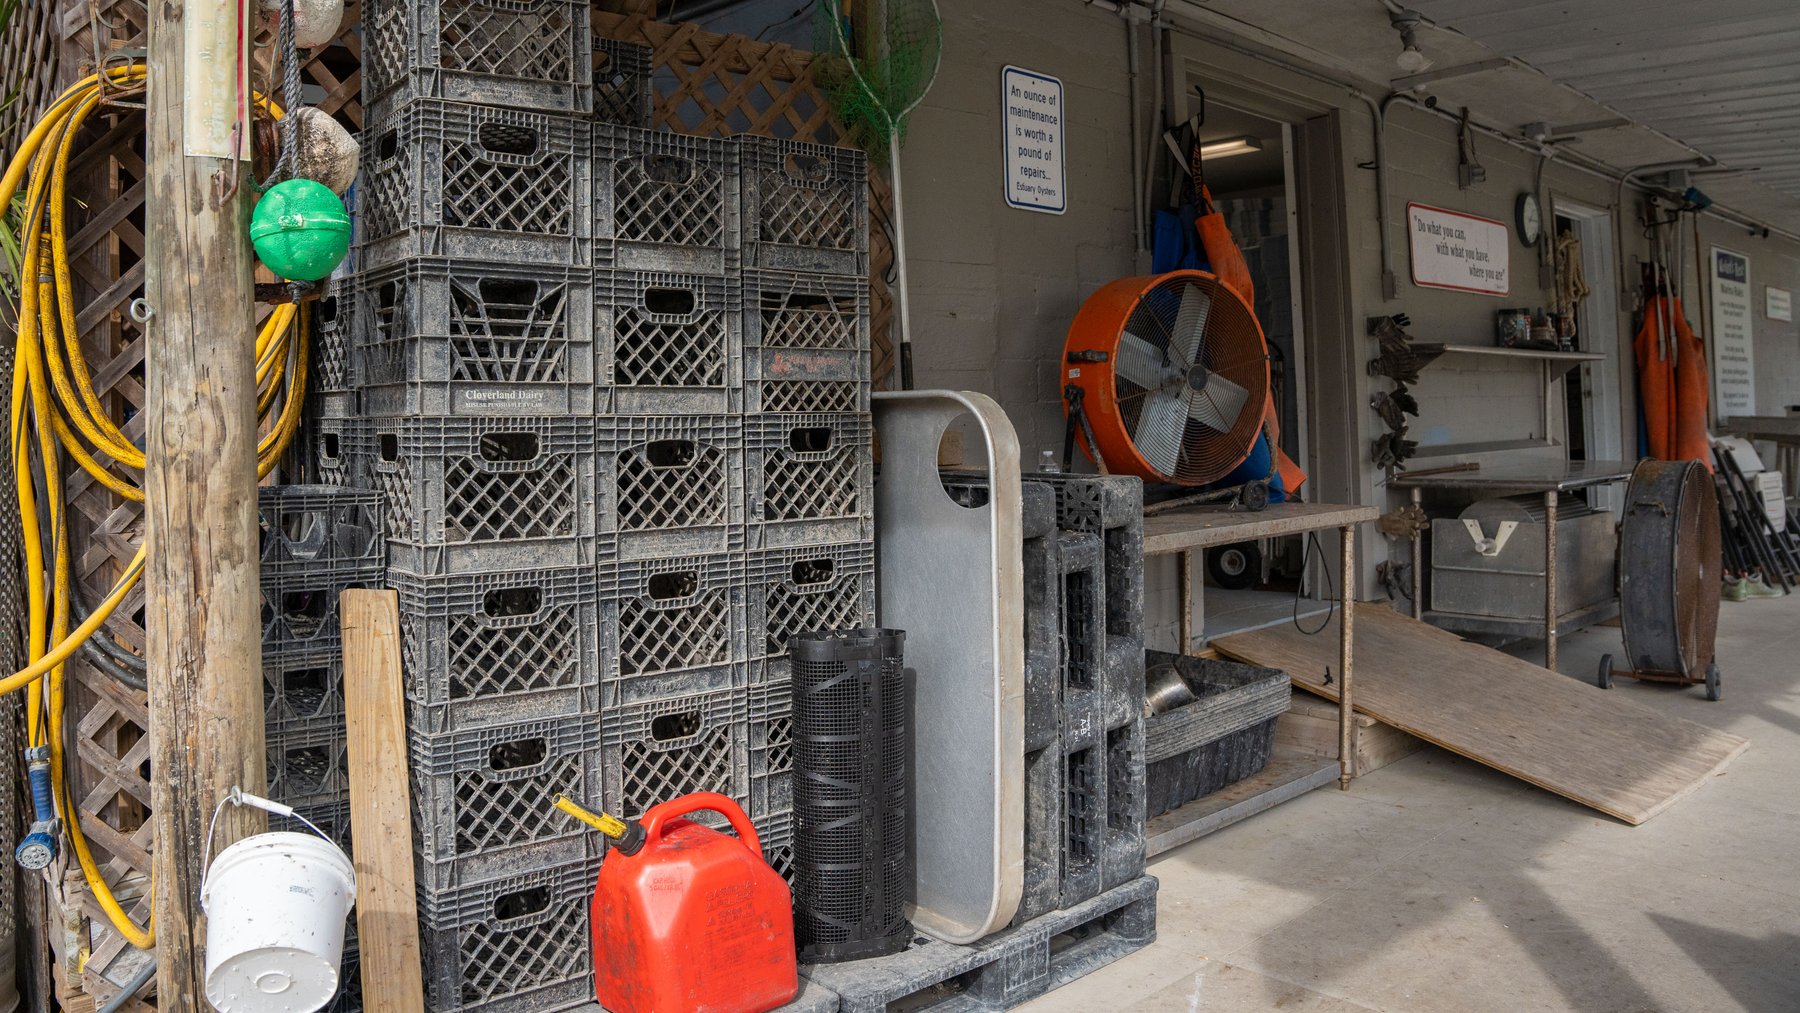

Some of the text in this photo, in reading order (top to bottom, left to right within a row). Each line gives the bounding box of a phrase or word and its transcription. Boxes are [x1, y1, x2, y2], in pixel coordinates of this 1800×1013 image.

[1011, 84, 1057, 106] An ounce of
[1009, 105, 1058, 125] maintenance
[1015, 124, 1053, 143] is worth a
[1018, 146, 1052, 161] pound of
[1016, 181, 1056, 197] Estuary Oysters
[1427, 221, 1442, 236] what
[1443, 226, 1454, 240] you
[1454, 228, 1467, 241] can,
[1435, 242, 1490, 263] with what you have,
[1468, 264, 1484, 279] where
[1485, 268, 1494, 282] you
[465, 389, 544, 401] Cloverland Dairy
